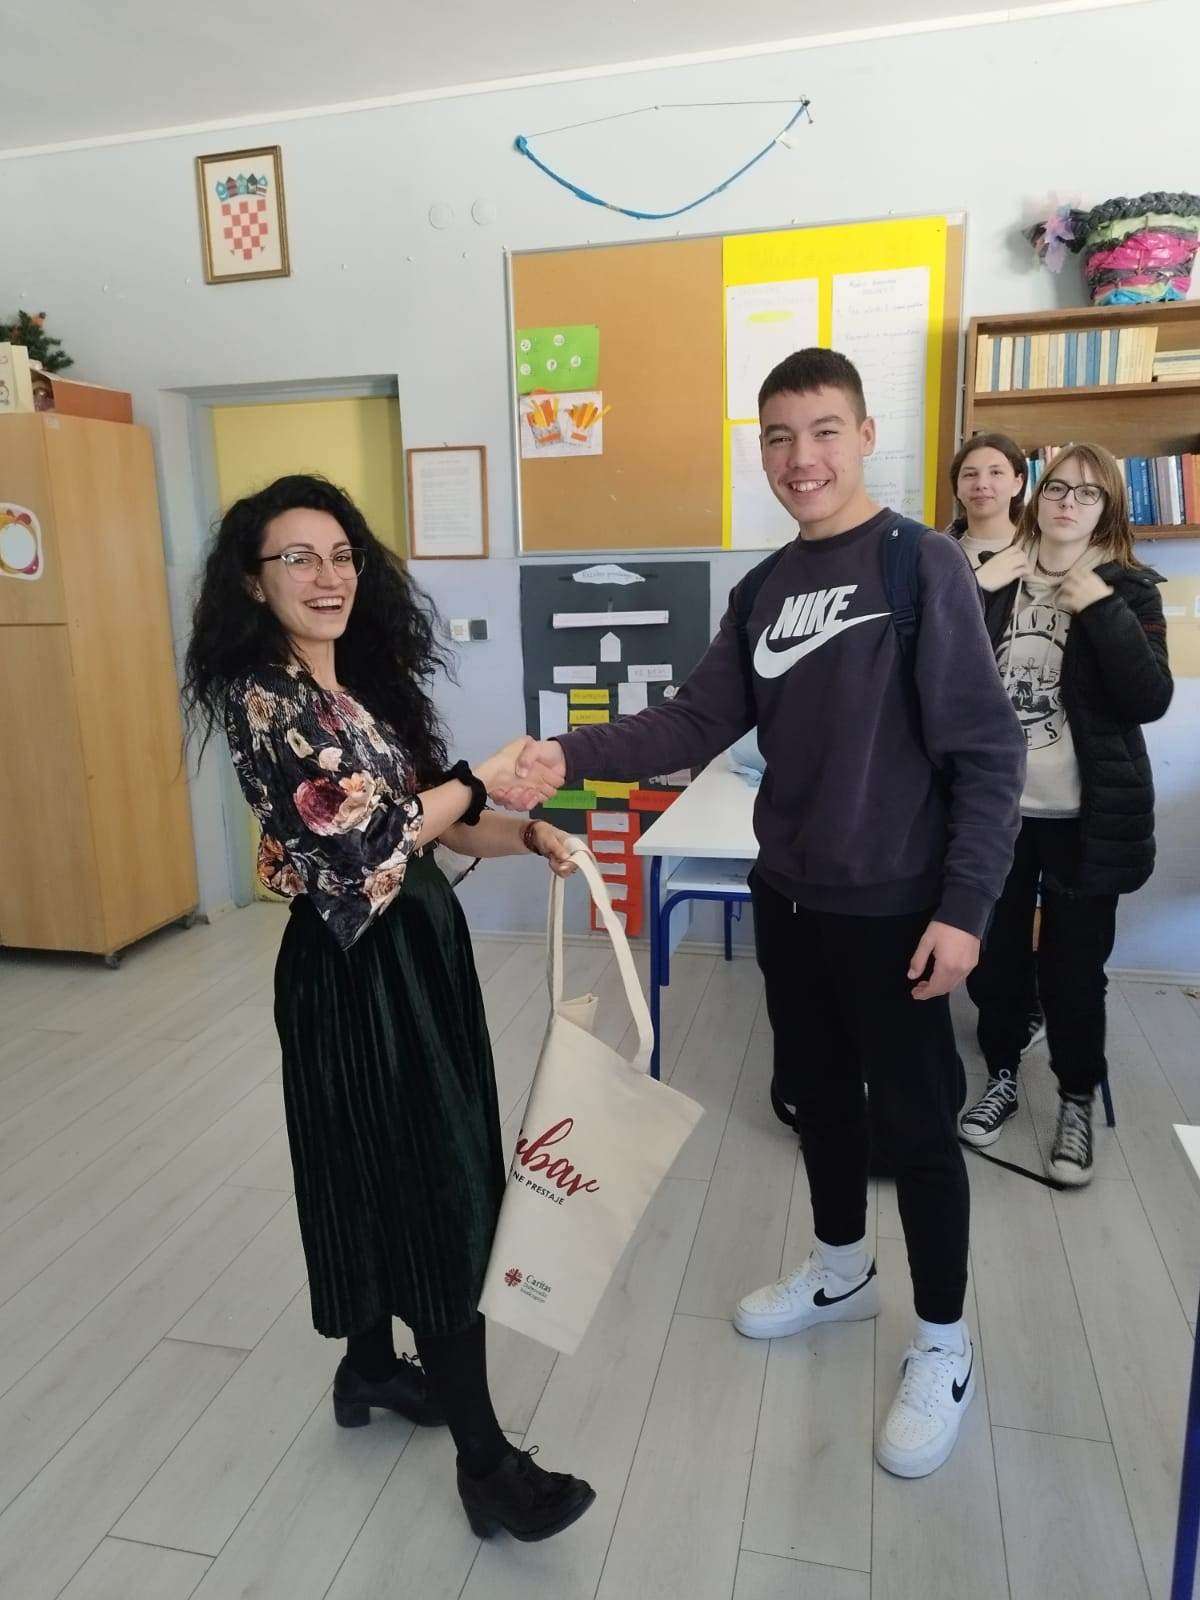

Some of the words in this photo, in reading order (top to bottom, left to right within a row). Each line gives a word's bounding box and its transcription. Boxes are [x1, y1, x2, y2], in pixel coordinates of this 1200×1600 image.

[769, 584, 858, 640] NIKE
[512, 1170, 526, 1184] NE
[525, 1180, 566, 1206] PRESTAJE
[525, 1274, 551, 1293] Caritas
